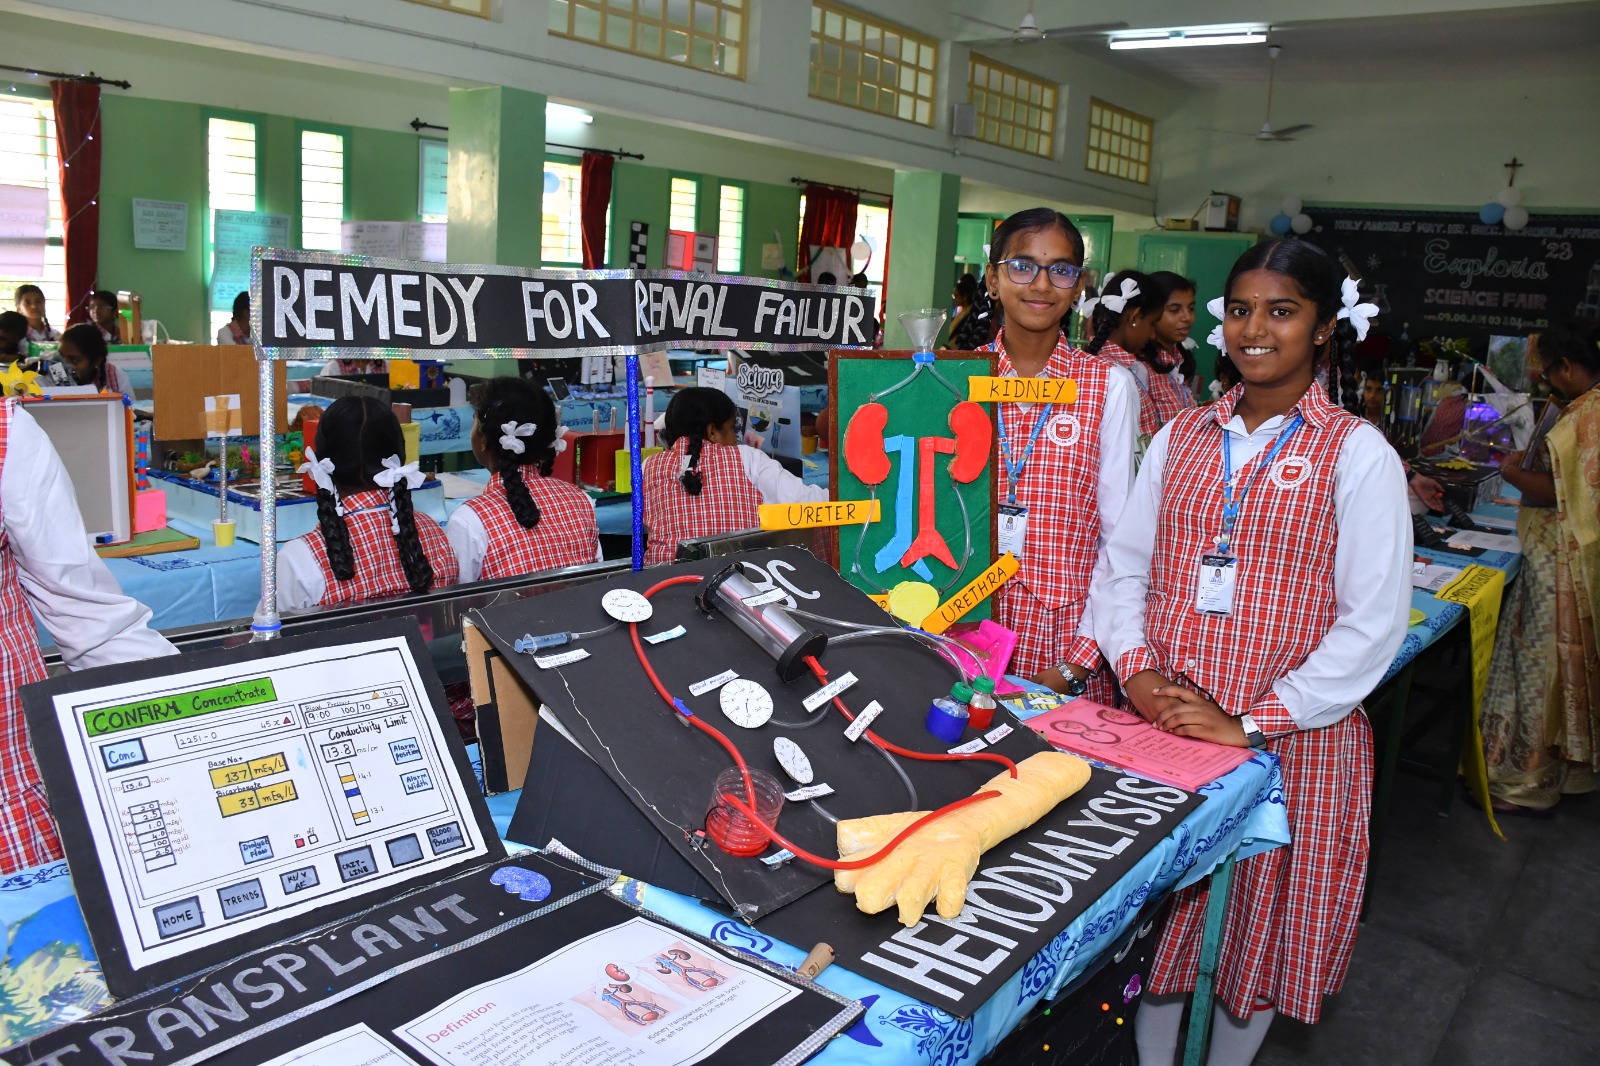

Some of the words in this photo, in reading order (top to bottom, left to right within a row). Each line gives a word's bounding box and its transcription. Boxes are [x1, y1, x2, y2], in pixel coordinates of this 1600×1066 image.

[1424, 239, 1549, 288] Exploria
[273, 266, 485, 346] REMEDY
[522, 281, 611, 342] FOR
[635, 279, 738, 337] RENAL
[754, 291, 866, 345] FAILUR
[1424, 288, 1500, 308] SCIENCE
[1503, 292, 1548, 310] FAIR
[738, 364, 783, 394] Science
[990, 380, 1065, 400] KIDNEY
[788, 503, 856, 526] URETER
[941, 566, 1007, 622] URETHRA
[93, 701, 182, 732] CONFIRM
[192, 686, 267, 711] Concentrate
[308, 710, 331, 720] 9:00
[328, 722, 382, 740] Conductivity
[384, 714, 408, 729] Limit
[326, 743, 352, 758] 13.8
[394, 742, 416, 751] Alarm
[395, 748, 420, 762] position
[108, 750, 136, 764] Conc
[224, 768, 248, 784] 137
[406, 772, 428, 782] Alarm
[407, 780, 429, 791] Width
[239, 796, 256, 809] 33
[154, 840, 167, 848] 100
[224, 890, 260, 906] TRENDS
[861, 778, 1188, 1001] HEMODIALYSIS
[162, 910, 194, 928] HOME
[28, 894, 478, 1066] TRANSPLANT
[426, 1002, 496, 1043] Definition
[538, 1022, 572, 1038] replacing
[454, 1036, 480, 1050] When
[480, 1026, 494, 1039] you
[493, 1016, 510, 1028] have
[462, 1032, 504, 1056] transplant,
[502, 1015, 529, 1032] doctors
[470, 1046, 492, 1062] organ
[491, 1035, 511, 1048] from
[512, 1019, 538, 1036] another
[492, 1044, 512, 1060] place
[528, 1024, 544, 1040] your
[536, 1034, 559, 1050] absent
[560, 1042, 587, 1060] doctors
